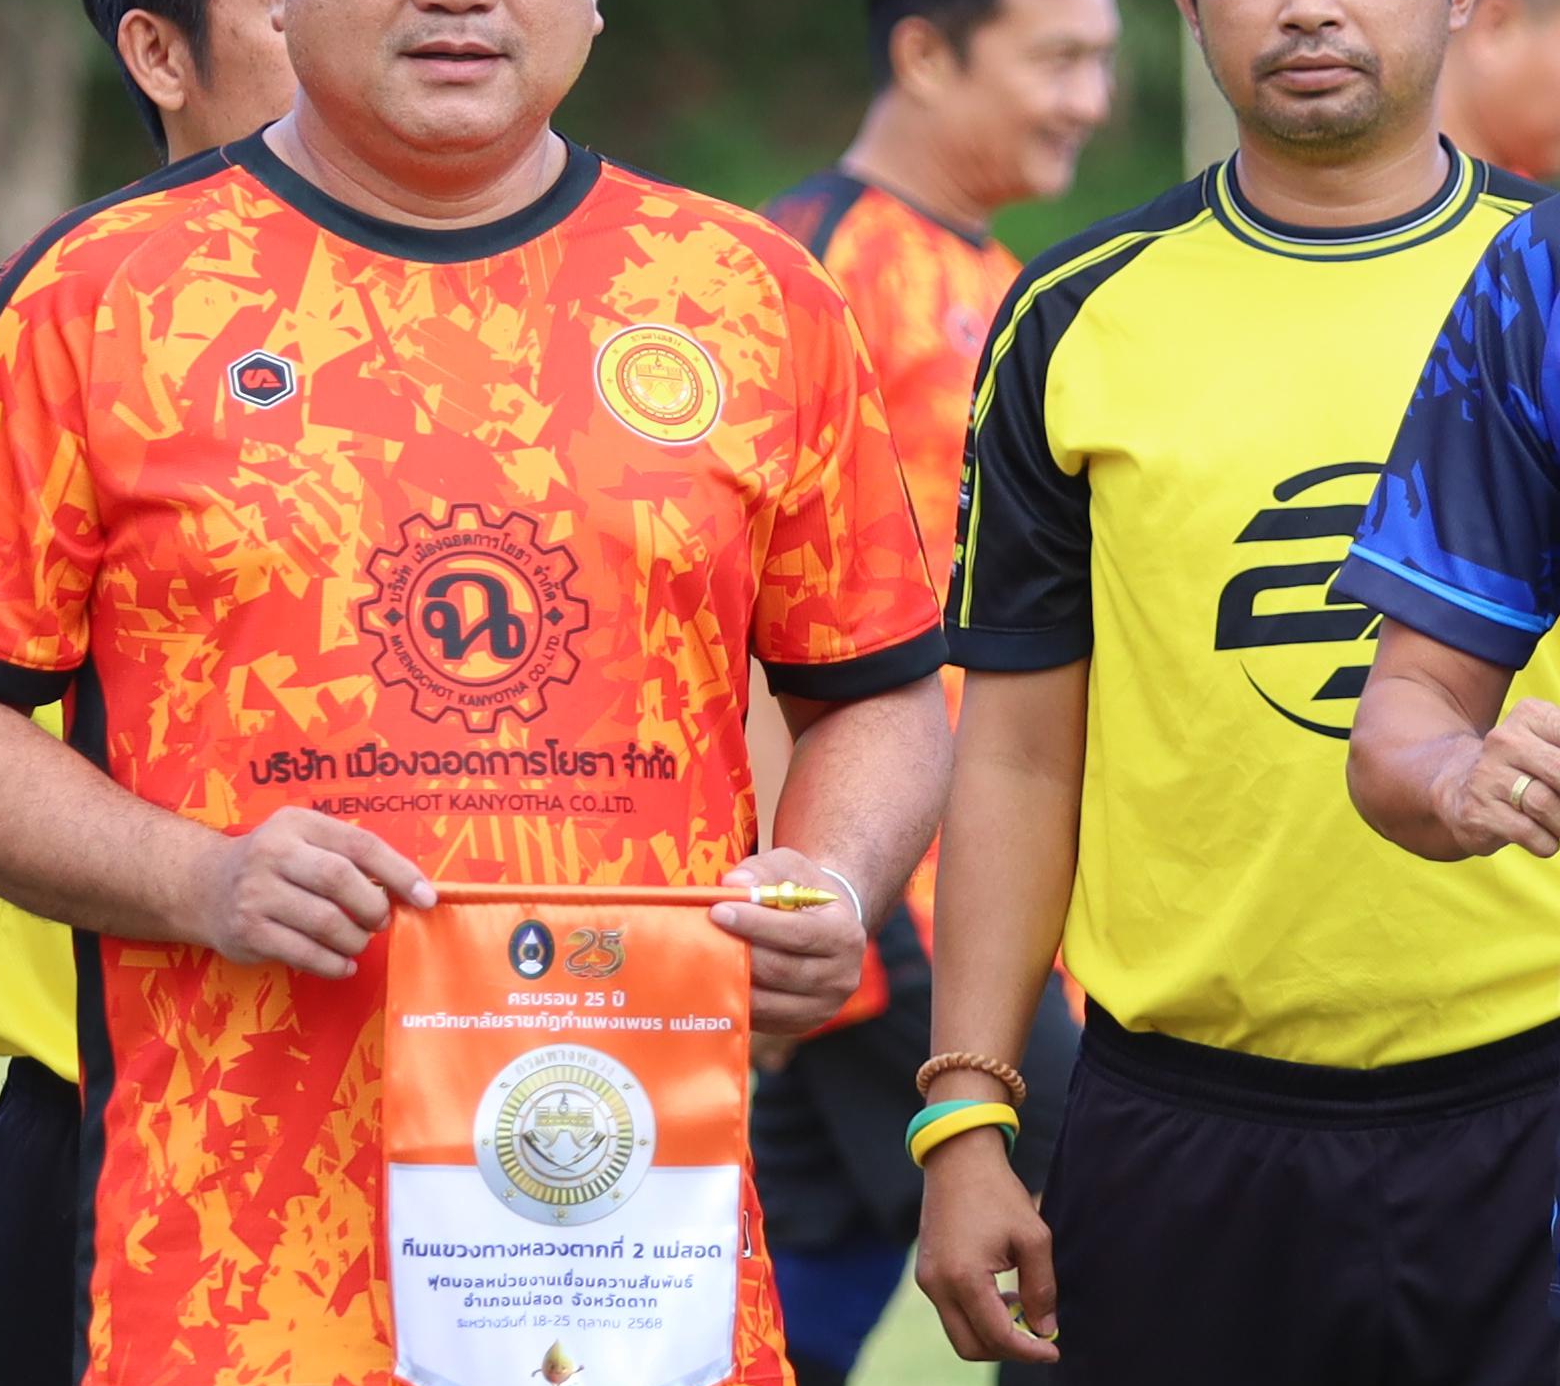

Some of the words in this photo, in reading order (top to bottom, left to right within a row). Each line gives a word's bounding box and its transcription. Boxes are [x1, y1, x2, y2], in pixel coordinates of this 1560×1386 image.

[249, 746, 337, 786] บริษัท
[346, 739, 615, 779] เมืองฉอดการโยธา
[622, 742, 678, 781] จำกัด
[450, 793, 562, 812] KANYOTHA
[508, 991, 578, 1007] ครบรอบ
[584, 992, 605, 1007] 25
[612, 989, 625, 1007] ปี
[669, 1014, 732, 1031] แม่สอด
[401, 1235, 624, 1260] ทีมแขวงทางหลวงตากที่
[633, 1243, 645, 1259] 2
[653, 1239, 722, 1259] แม่สอด
[428, 1269, 694, 1290] ฟุตบอลหน่วยงานเชื่อมความสัมพันธ์
[463, 1291, 563, 1308] อำเภอแม่สอด
[571, 1292, 658, 1308] จังหวัดตาก
[457, 1313, 527, 1330] ระหว่างวันที่
[532, 1315, 571, 1328] 18-25
[576, 1317, 621, 1331] ตุลาคม
[627, 1316, 664, 1330] 2568
